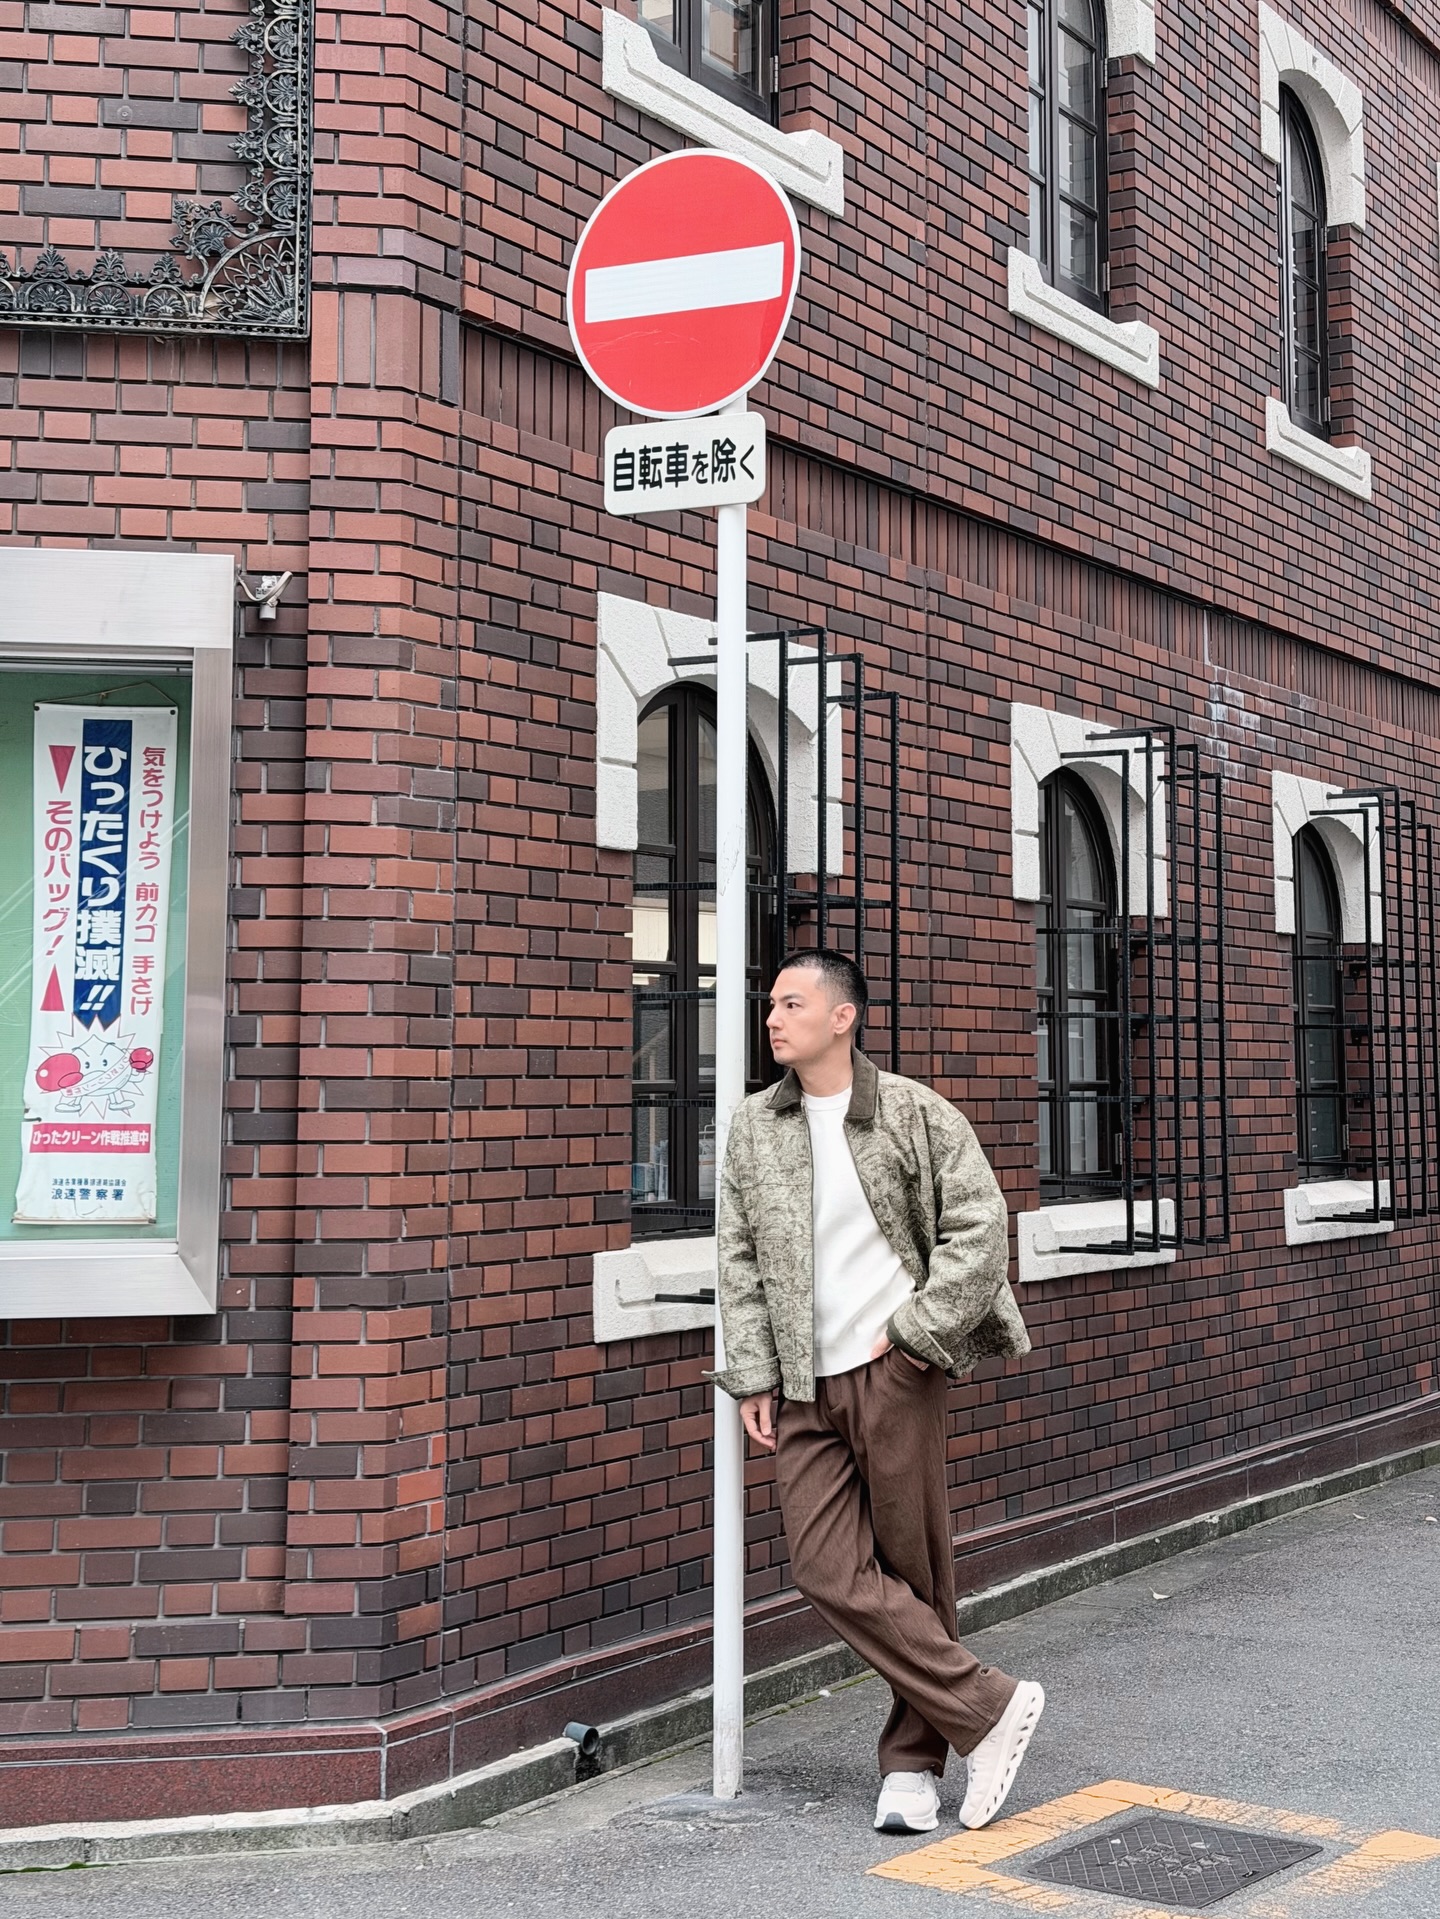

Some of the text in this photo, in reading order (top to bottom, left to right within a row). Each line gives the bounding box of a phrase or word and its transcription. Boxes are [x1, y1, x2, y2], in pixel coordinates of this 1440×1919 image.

[613, 437, 755, 492] 自転車を除く
[42, 800, 74, 956] そのバッグ!
[74, 745, 127, 1011] ひったくり撲滅!!
[130, 746, 166, 1017] 気をつけよう 前カゴ 手さげ
